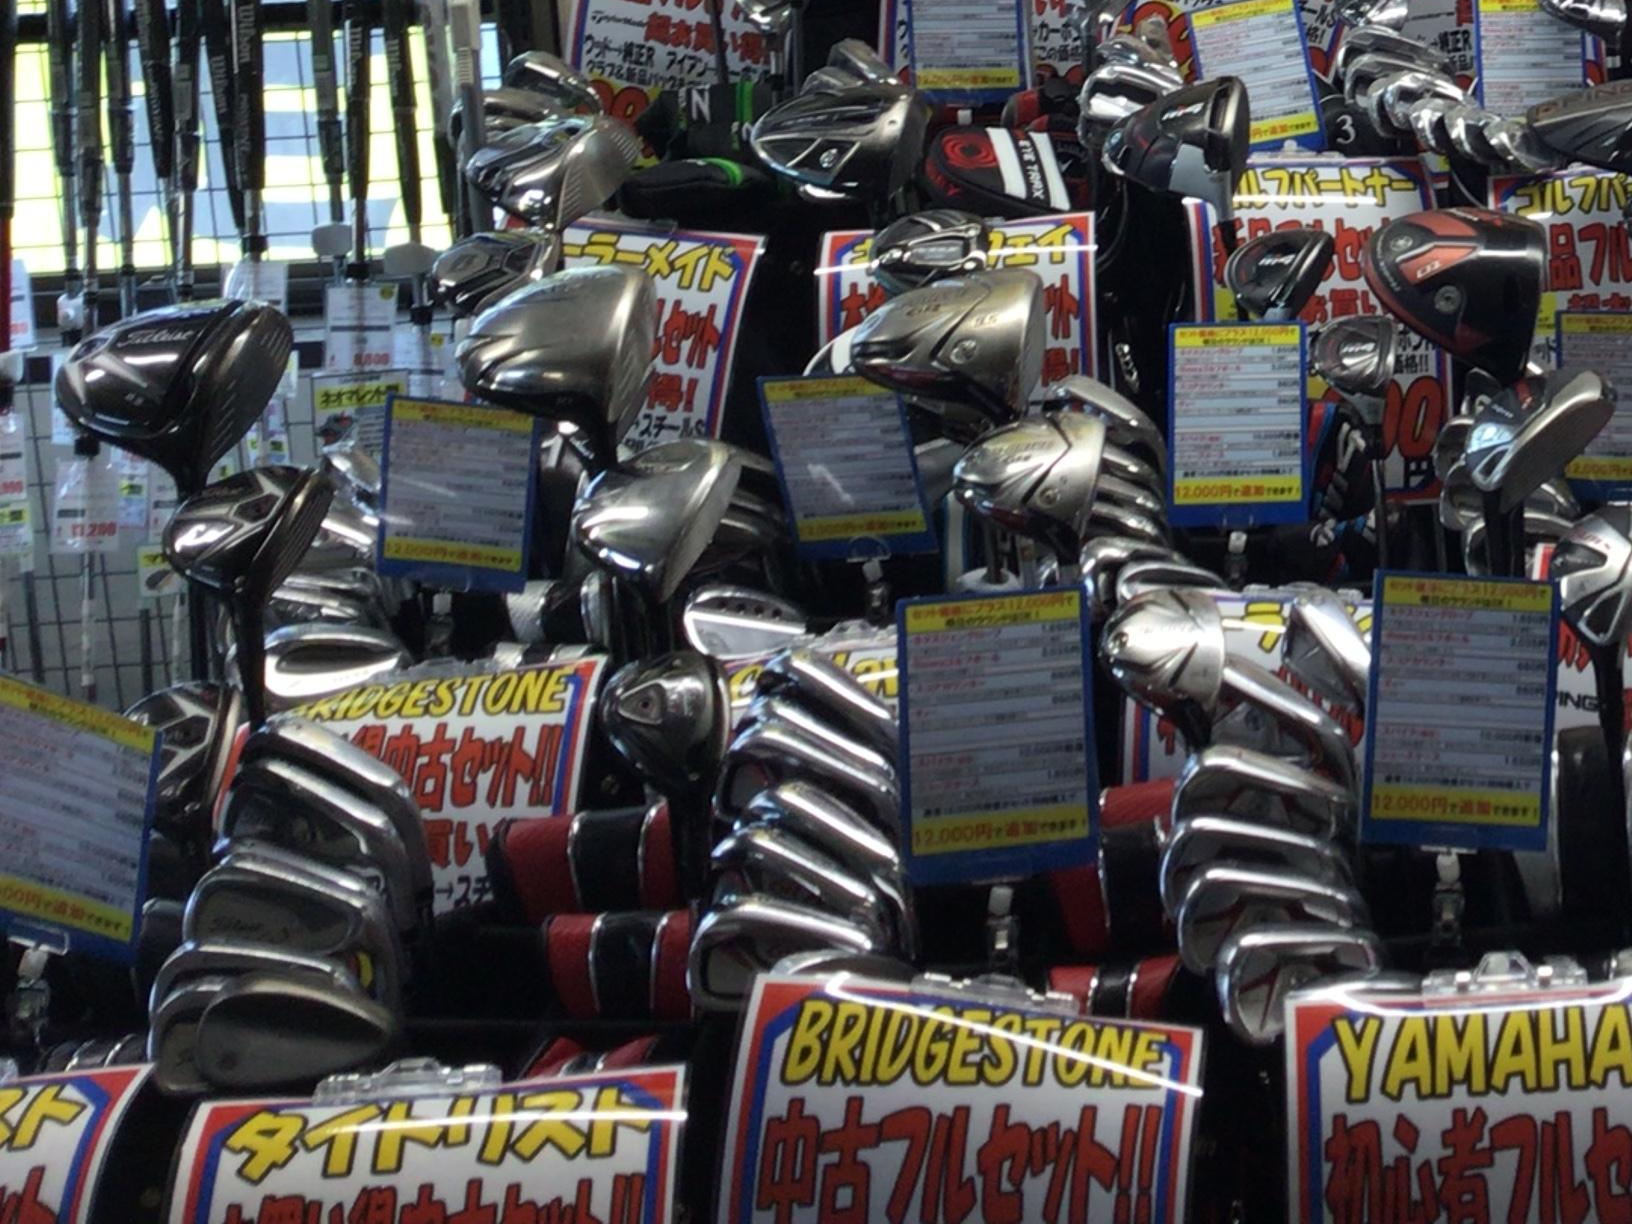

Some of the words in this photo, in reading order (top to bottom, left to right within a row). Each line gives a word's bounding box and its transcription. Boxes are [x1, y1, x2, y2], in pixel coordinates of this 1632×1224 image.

[1335, 114, 1357, 142] 3
[1232, 167, 1417, 210] ルフパートナー
[562, 232, 737, 292] ーラーメイド
[296, 665, 577, 723] RIDGESTONE
[780, 998, 1170, 1089] BRIDGESTONE
[225, 1085, 652, 1183] タイトリスト
[756, 1095, 1164, 1224] 中古フルセット!!
